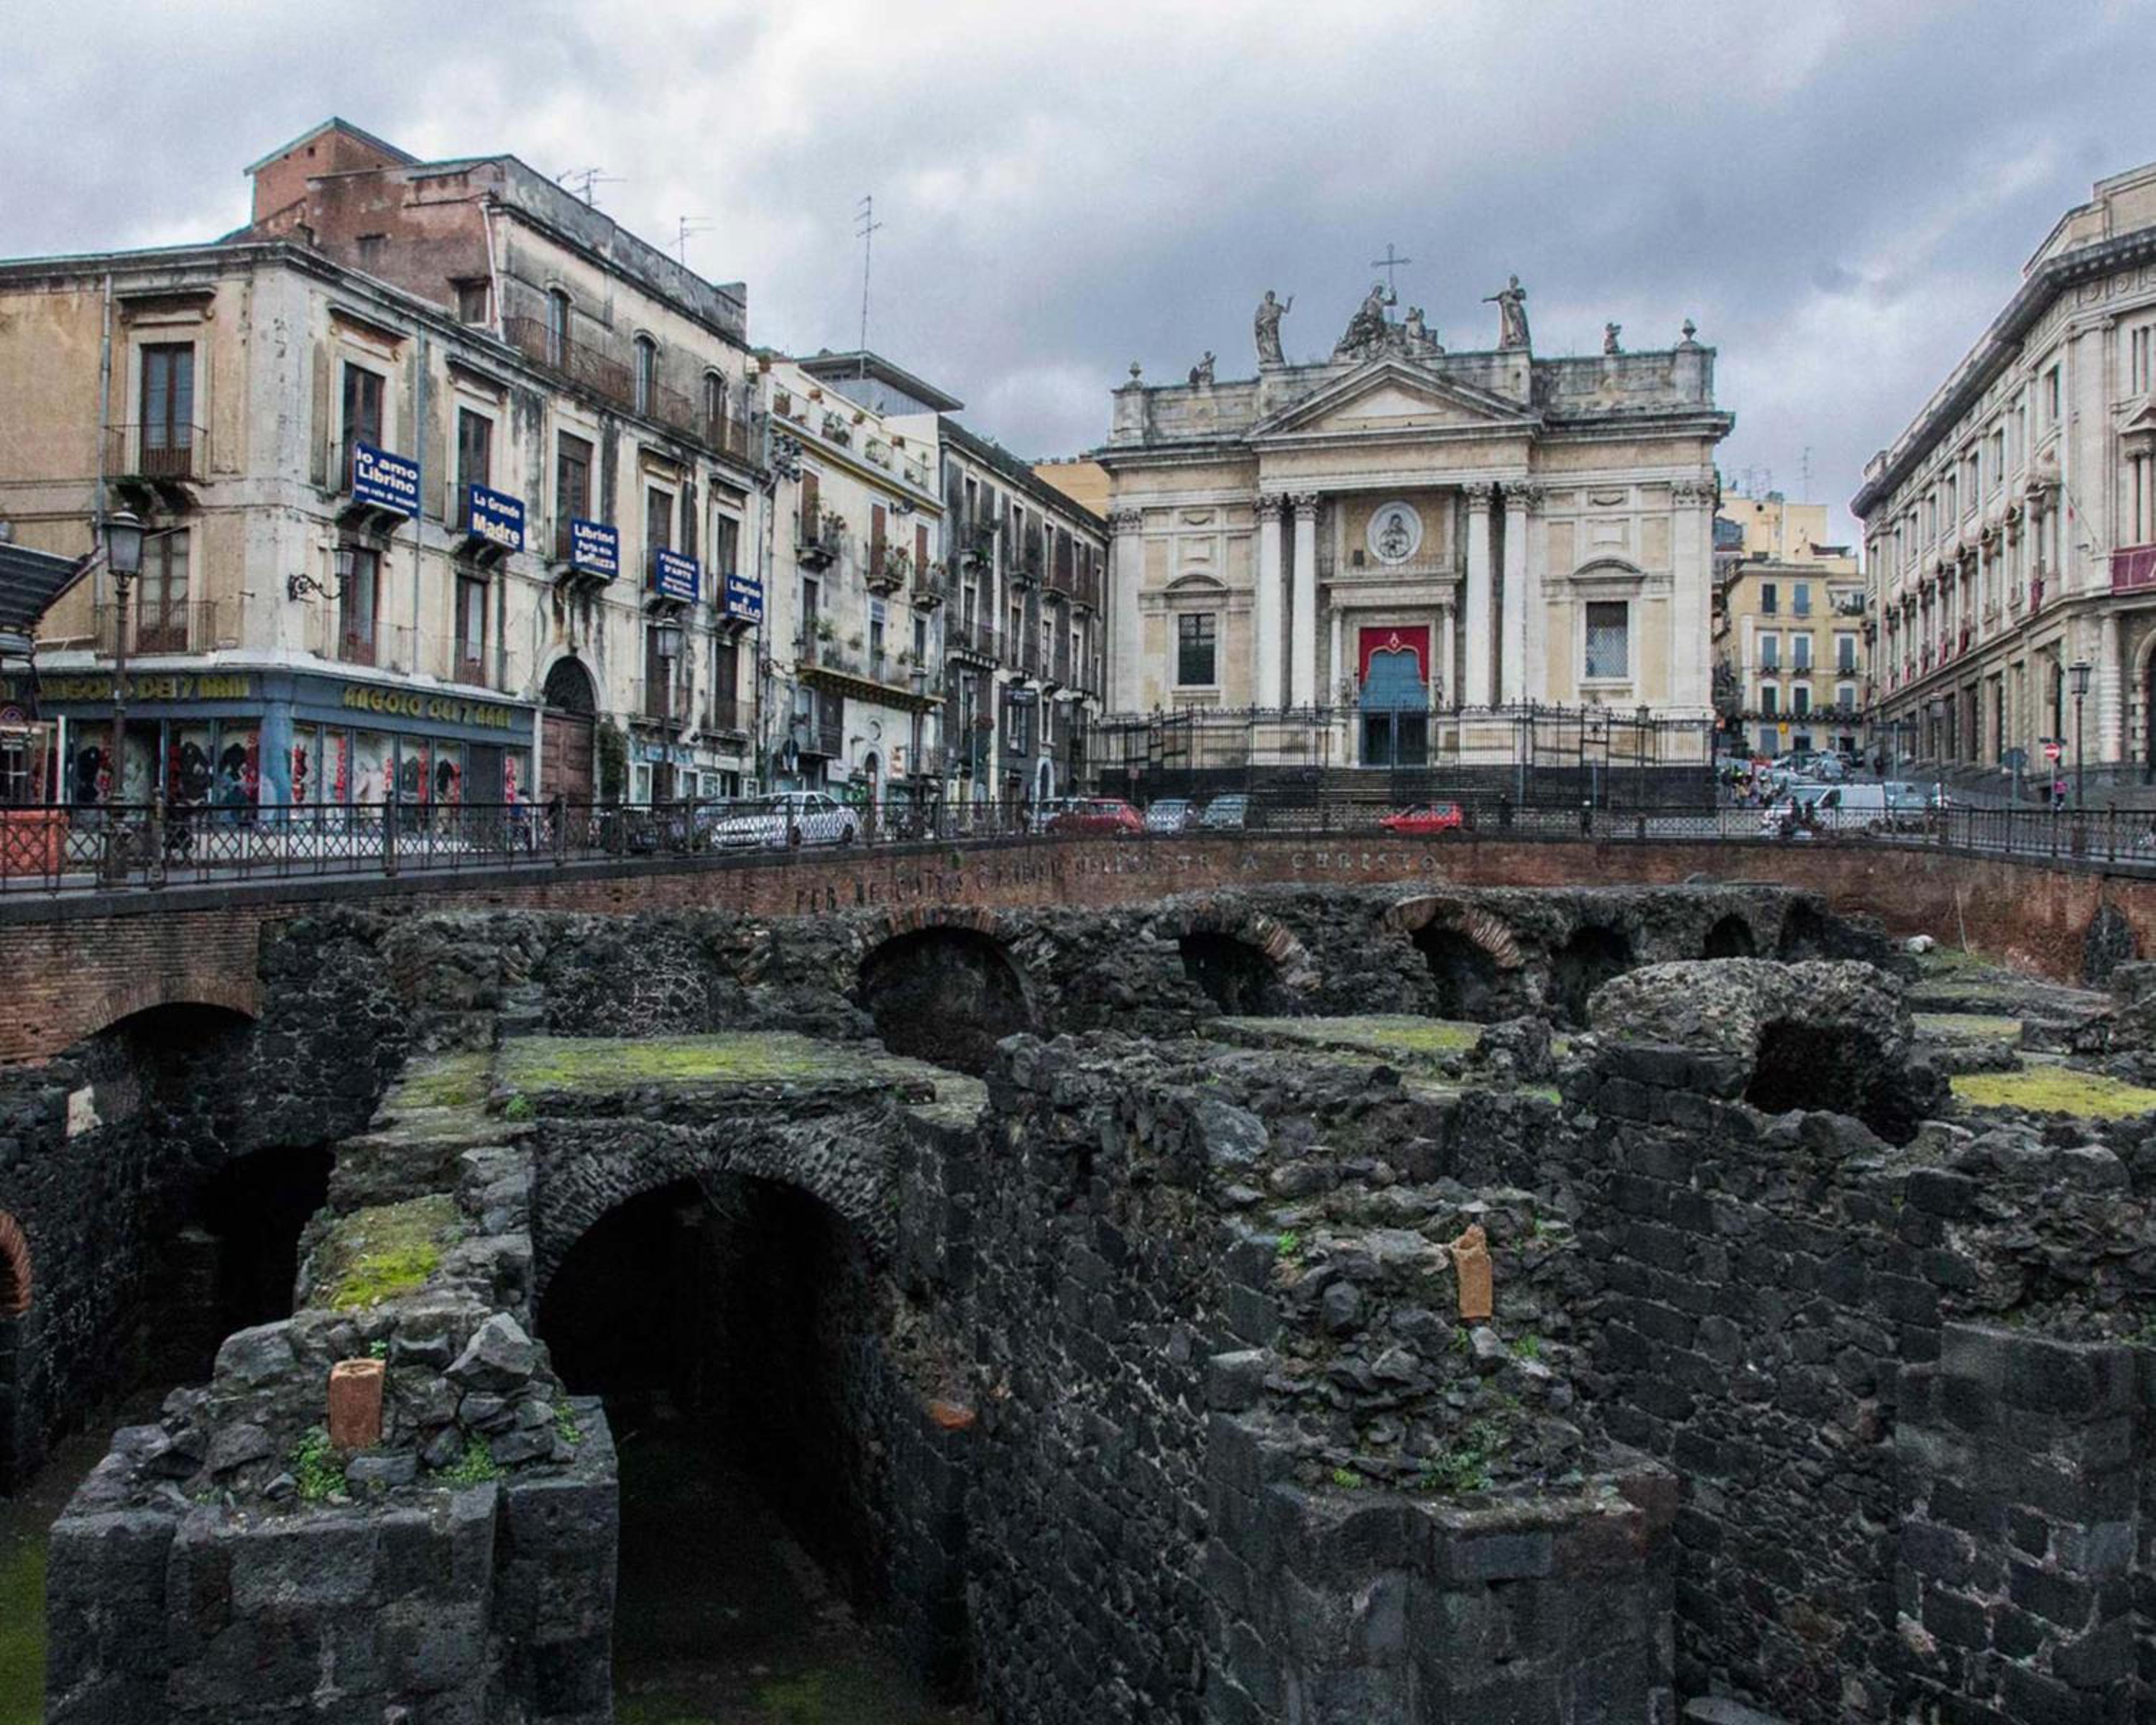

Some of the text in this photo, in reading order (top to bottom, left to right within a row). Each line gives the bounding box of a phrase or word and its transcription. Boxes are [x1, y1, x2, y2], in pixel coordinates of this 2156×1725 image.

[358, 462, 415, 494] Librino
[379, 458, 418, 480] amo
[473, 491, 487, 507] La
[472, 512, 520, 545] Madre
[574, 523, 615, 545] Librino
